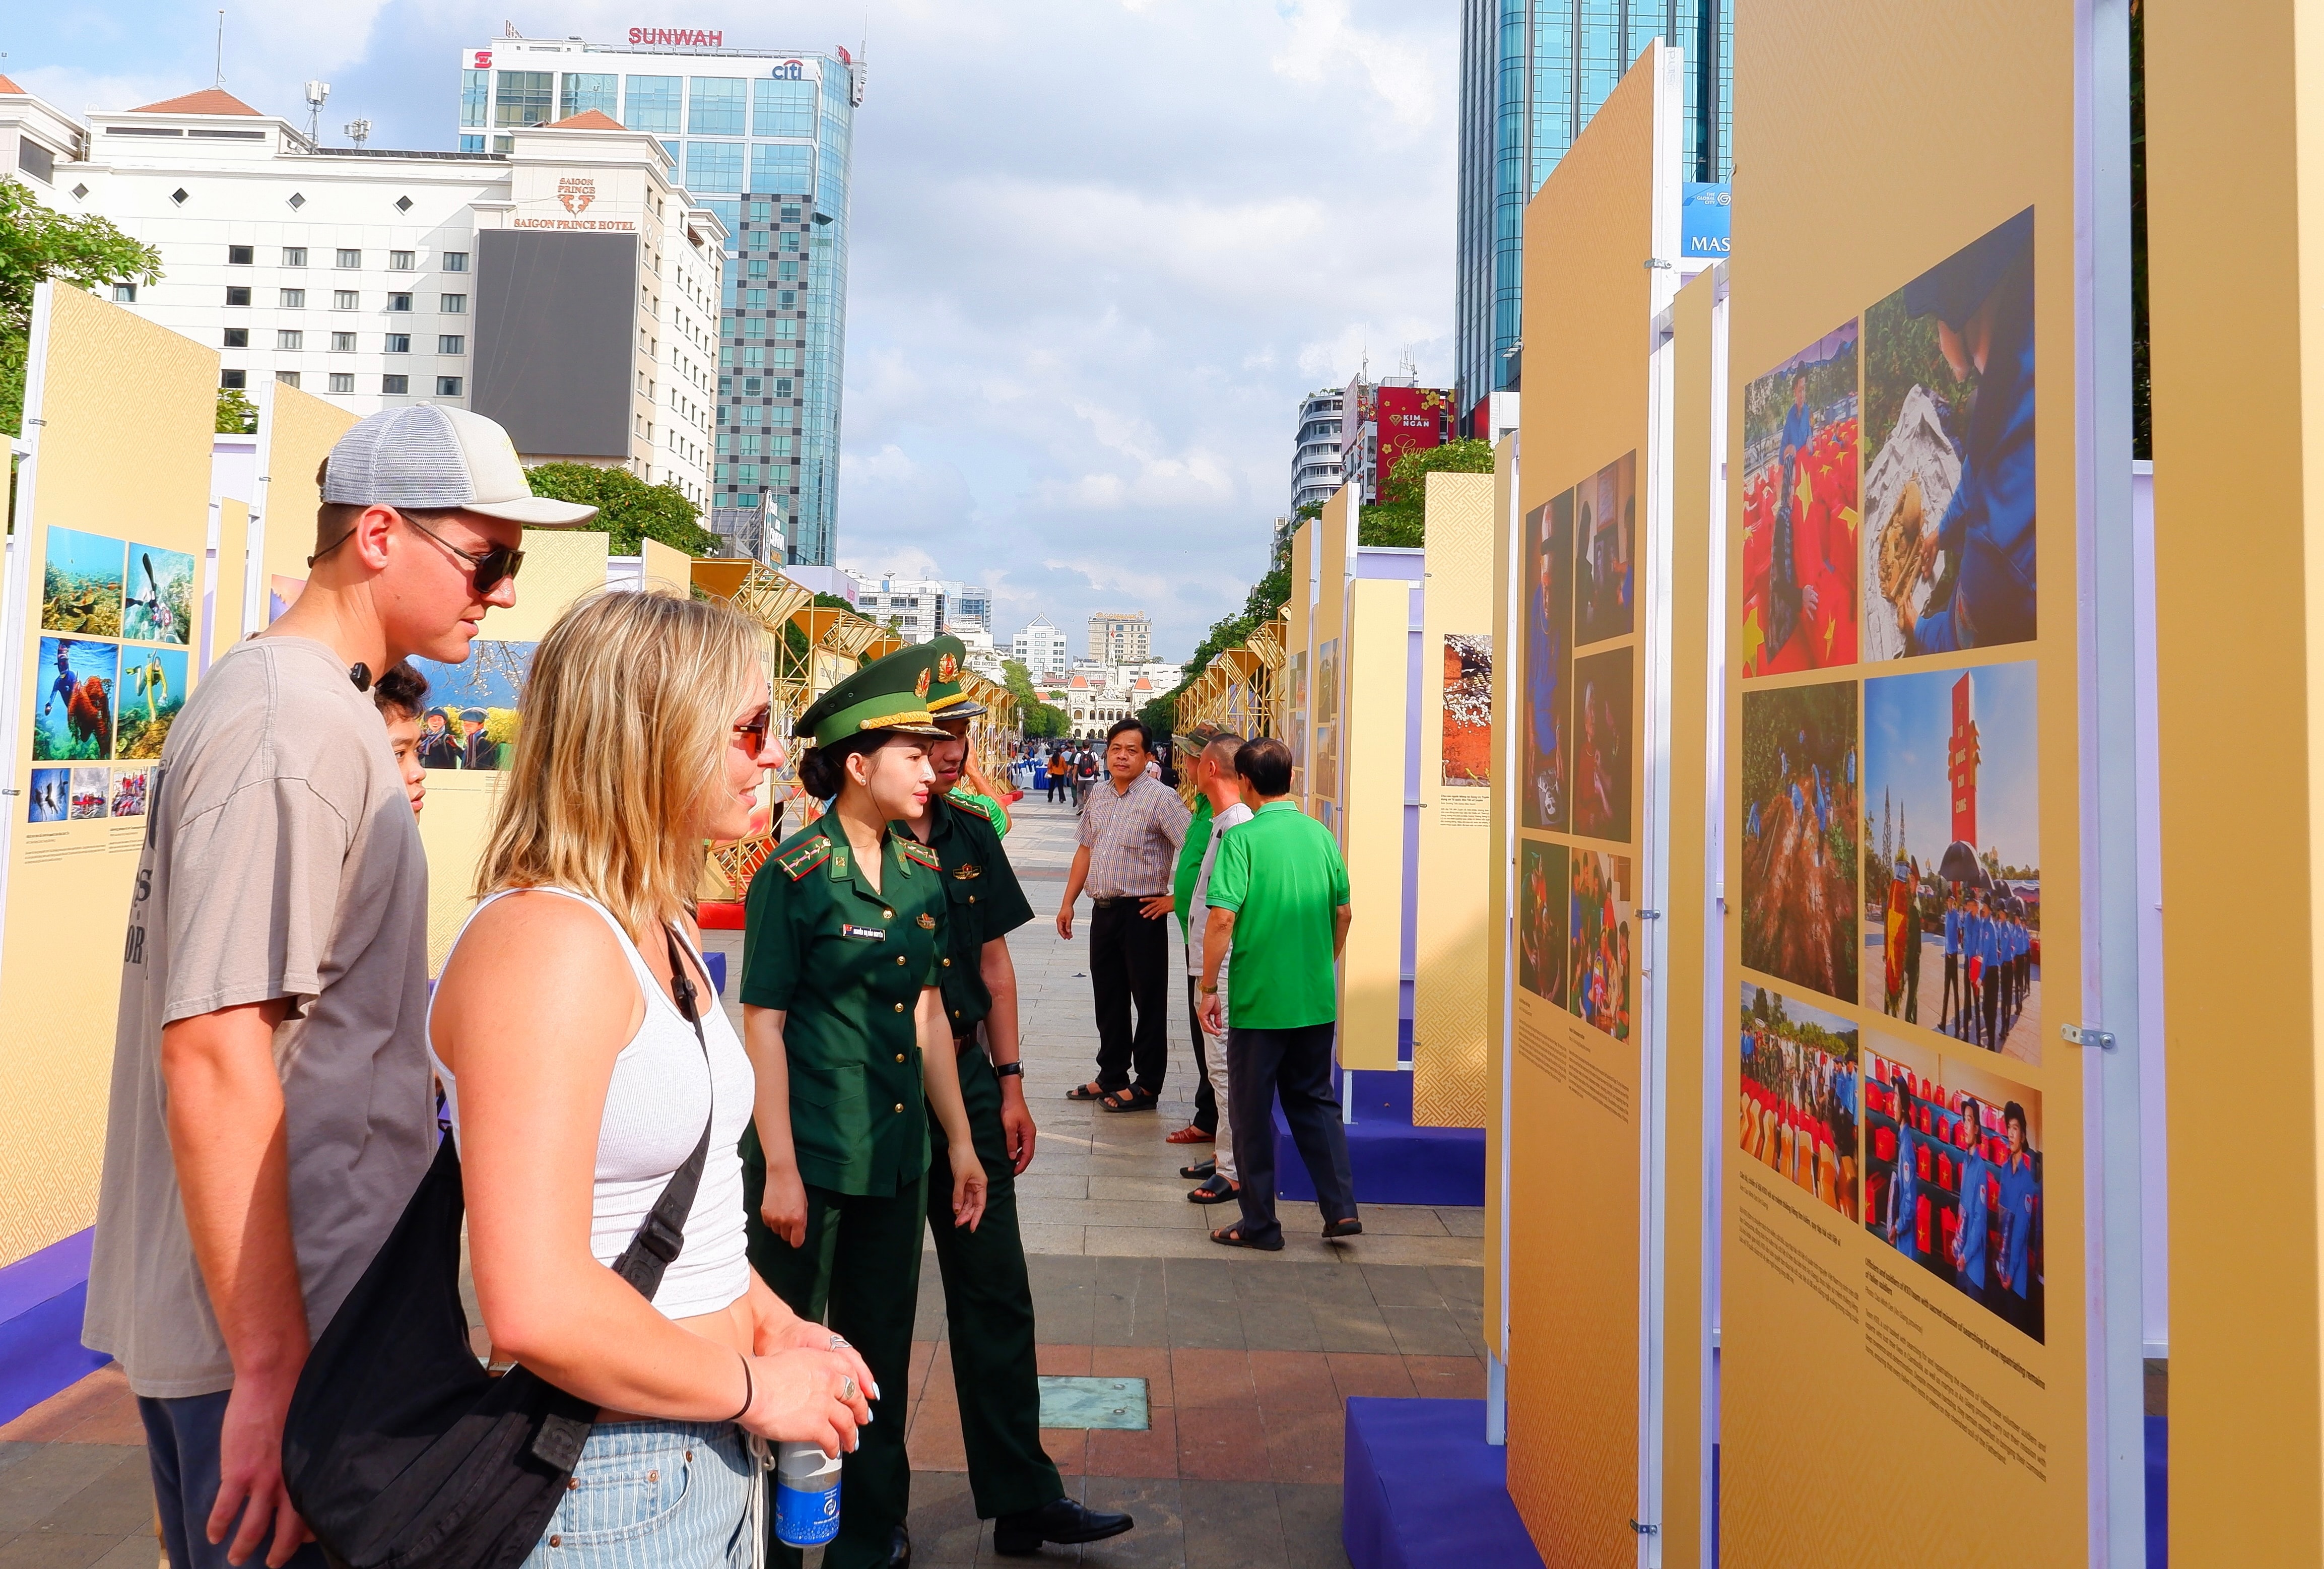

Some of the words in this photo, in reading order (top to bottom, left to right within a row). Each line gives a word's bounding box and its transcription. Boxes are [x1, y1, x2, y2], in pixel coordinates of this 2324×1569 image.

[629, 28, 722, 46] SUNWAH
[772, 60, 804, 80] citi
[558, 185, 595, 194] PRINCE
[514, 219, 555, 228] SAIGON
[557, 220, 596, 229] PRINCE
[598, 221, 636, 230] HOTEL
[1691, 236, 1731, 251] MAS
